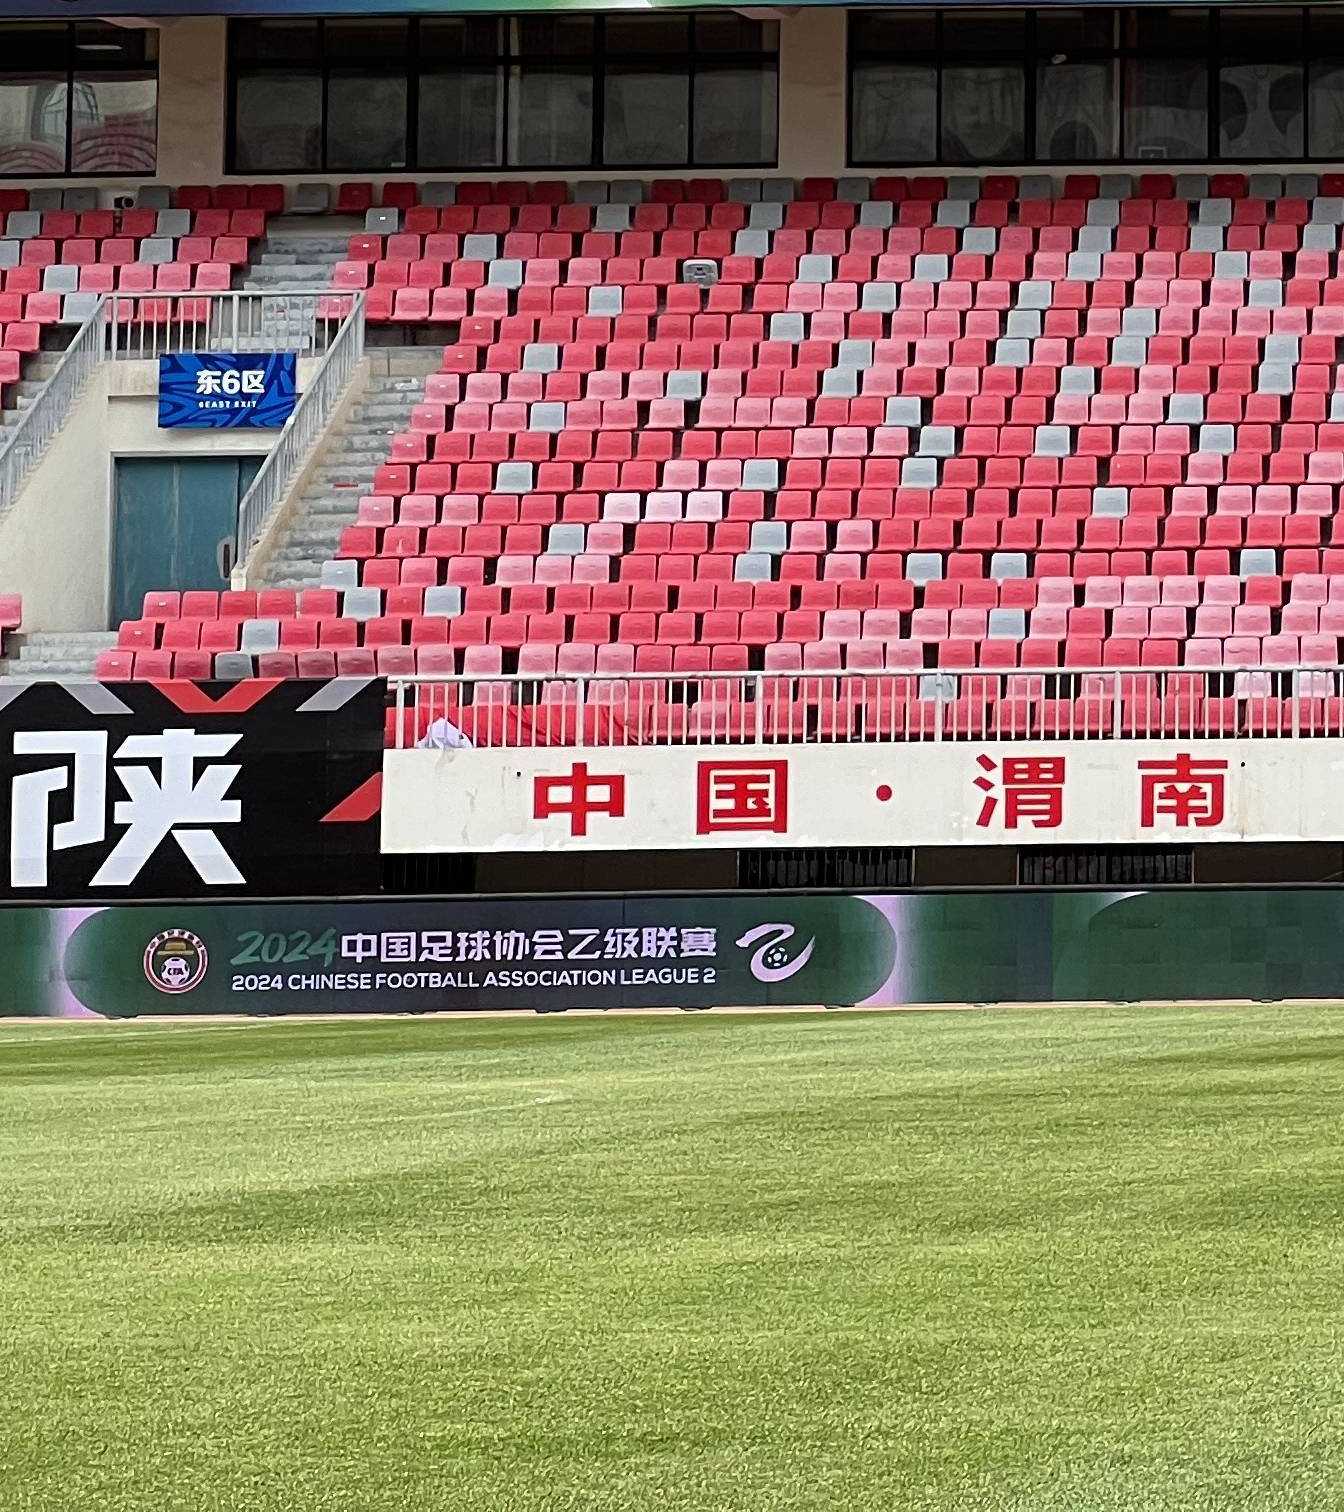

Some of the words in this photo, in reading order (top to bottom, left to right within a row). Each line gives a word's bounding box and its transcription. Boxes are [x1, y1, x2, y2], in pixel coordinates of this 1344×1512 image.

[196, 369, 265, 394] 东6区
[11, 728, 248, 887] 陕
[232, 974, 284, 991] 2024
[287, 973, 372, 990] CHINESE
[376, 971, 480, 989] FOOTBALL
[484, 969, 616, 987] ASSOCIATION
[620, 968, 700, 985] LEAGUE
[702, 968, 716, 984] 2
